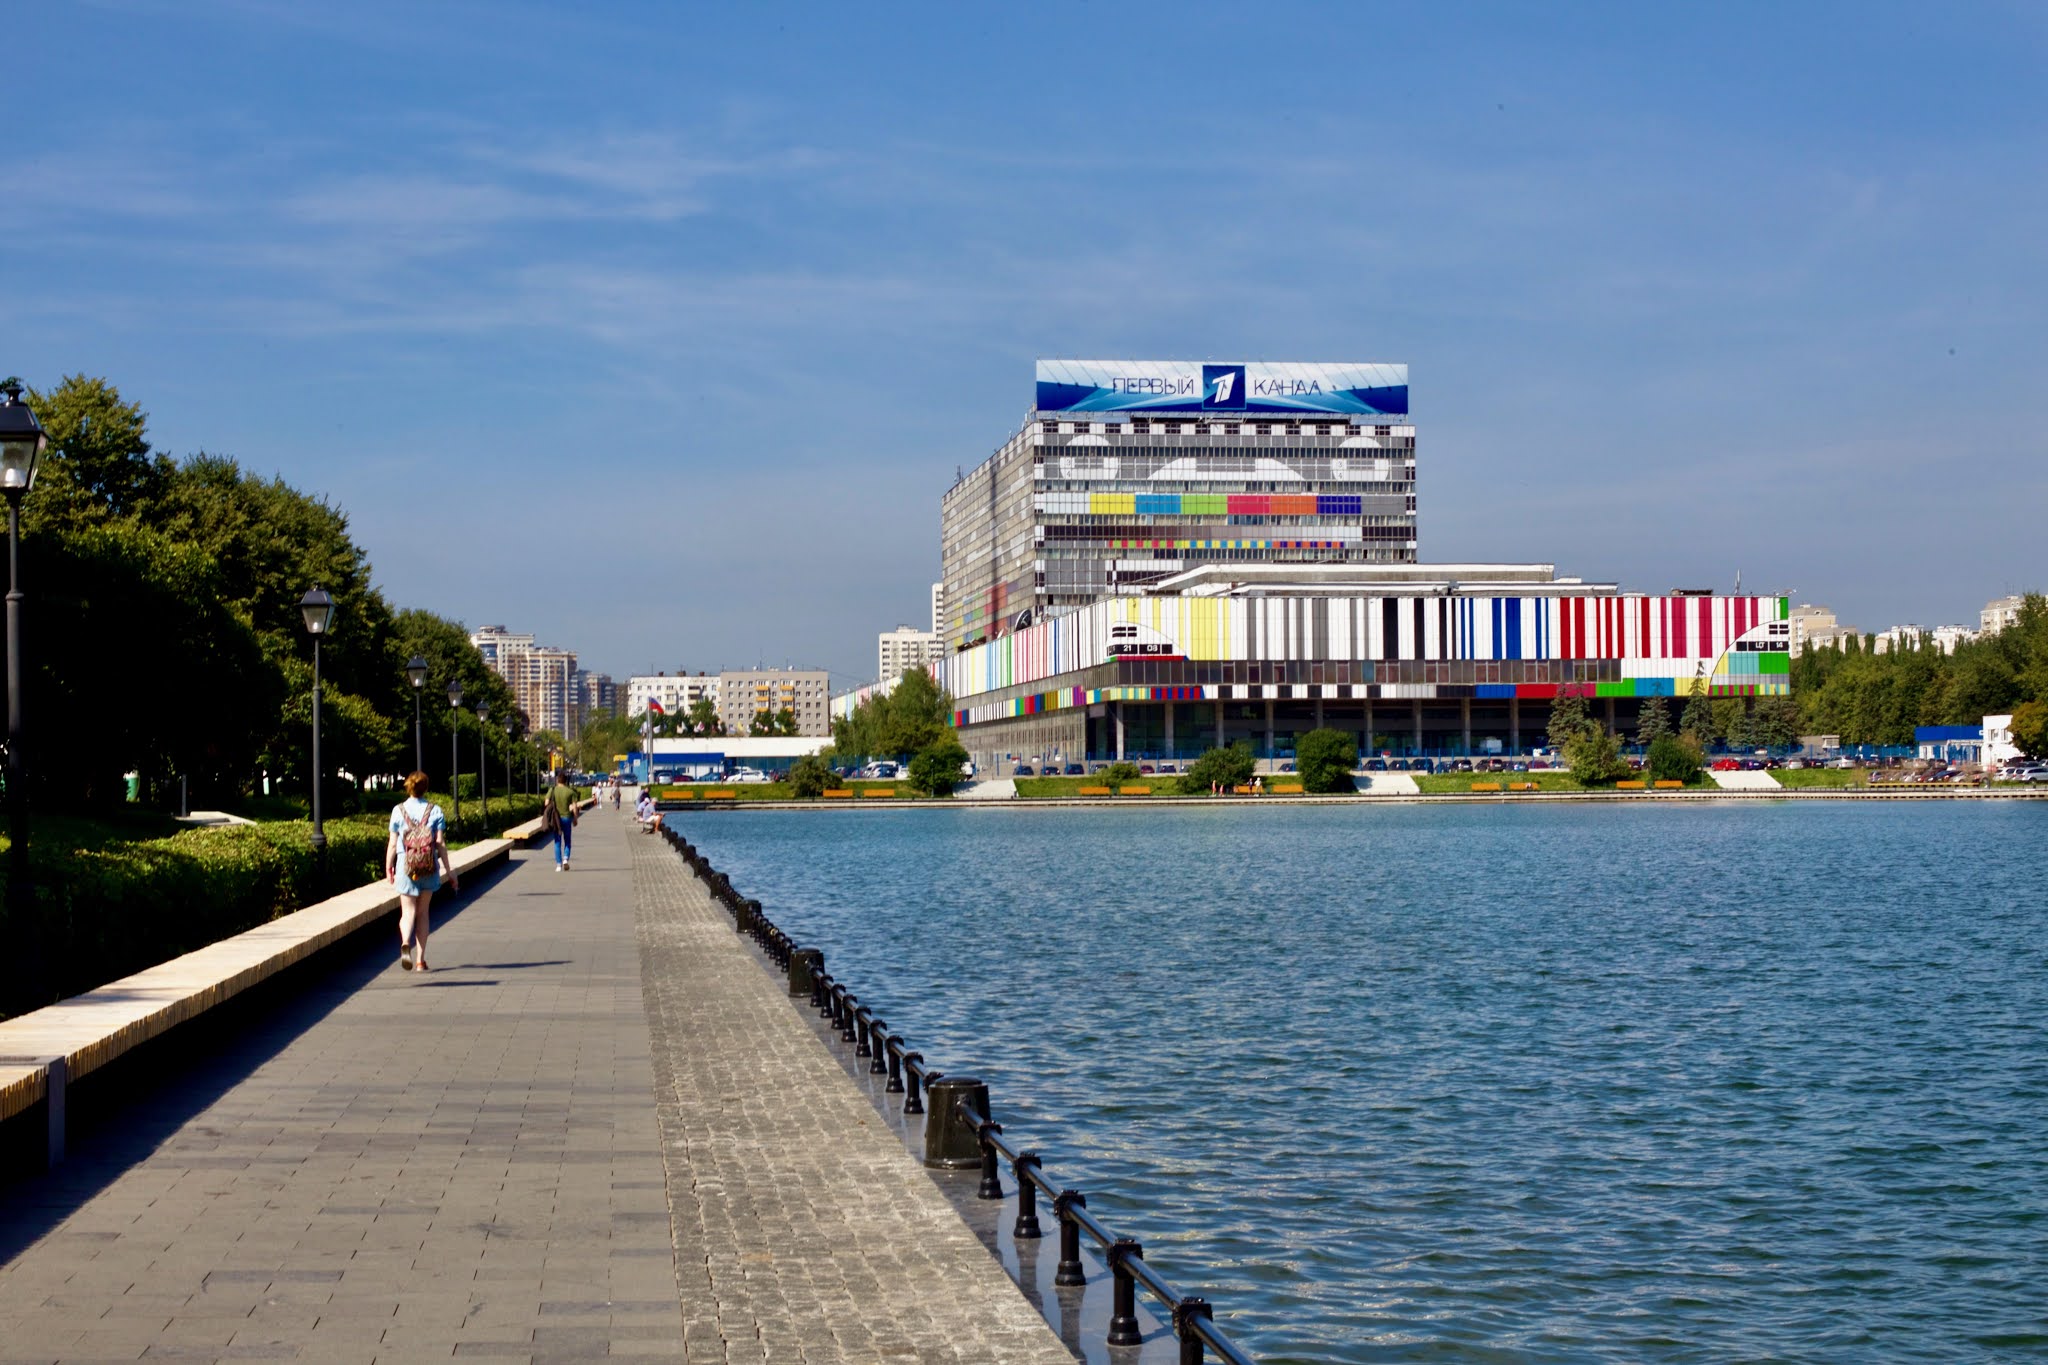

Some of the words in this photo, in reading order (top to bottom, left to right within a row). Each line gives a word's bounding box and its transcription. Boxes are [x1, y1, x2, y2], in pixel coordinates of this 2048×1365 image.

[1113, 375, 1194, 395] ПЕРВЫЙ
[1254, 379, 1322, 396] КАНАЛ
[1123, 644, 1132, 652] 21
